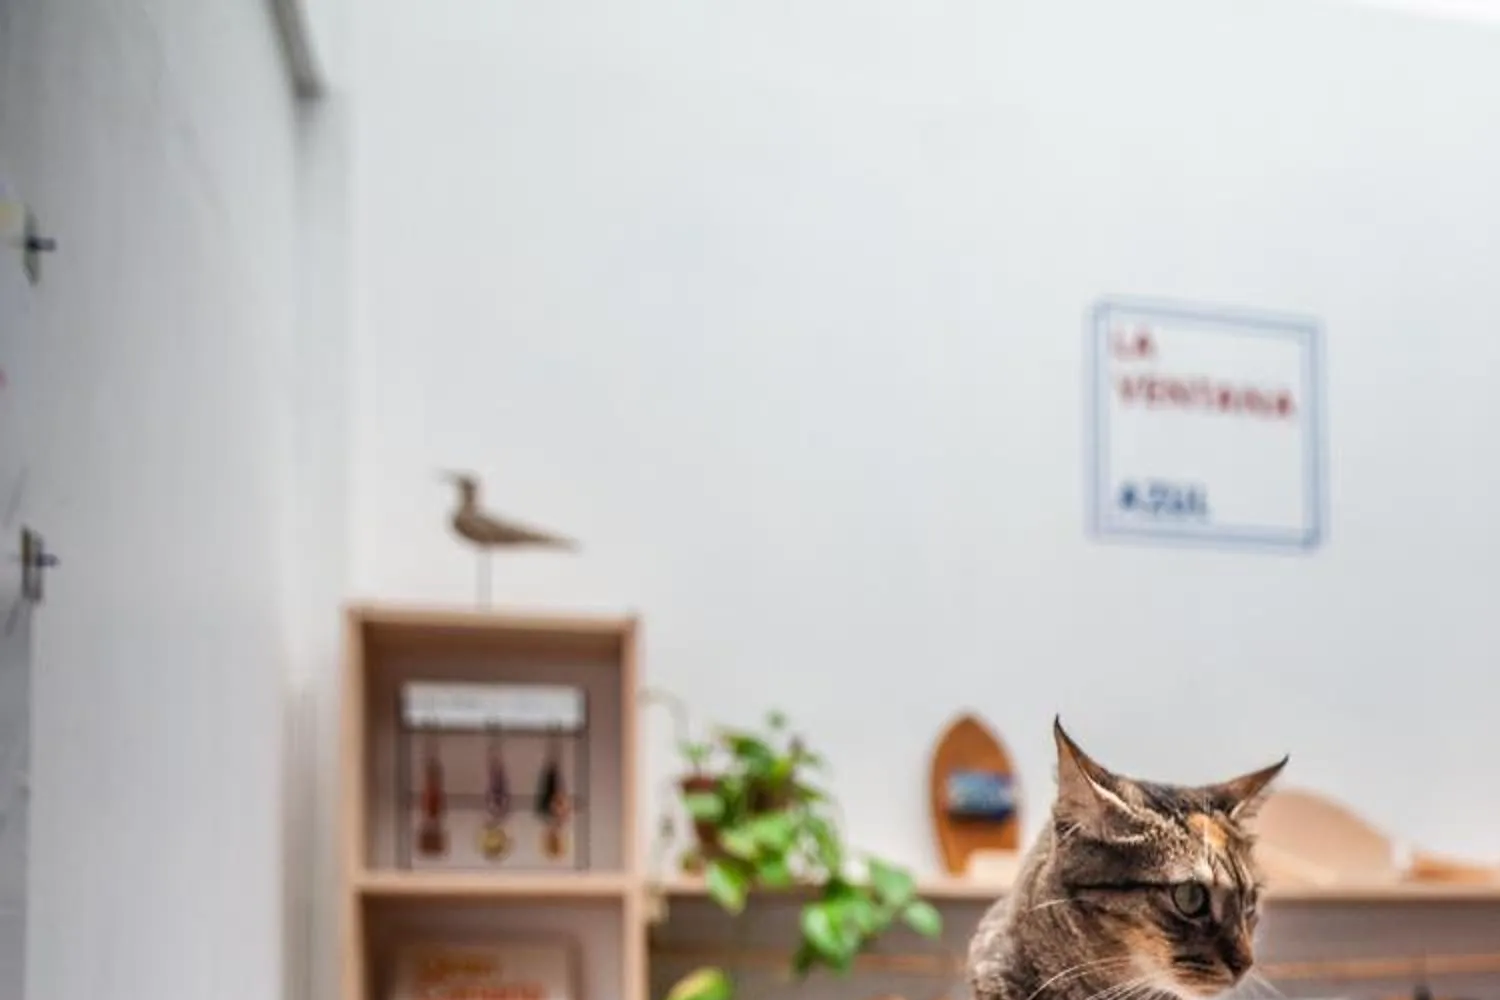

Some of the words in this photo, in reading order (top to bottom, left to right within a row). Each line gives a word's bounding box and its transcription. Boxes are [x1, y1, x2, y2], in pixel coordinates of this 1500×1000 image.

[1113, 326, 1156, 361] LA
[1117, 374, 1296, 420] VENTANA
[1118, 480, 1210, 521] AZUL
